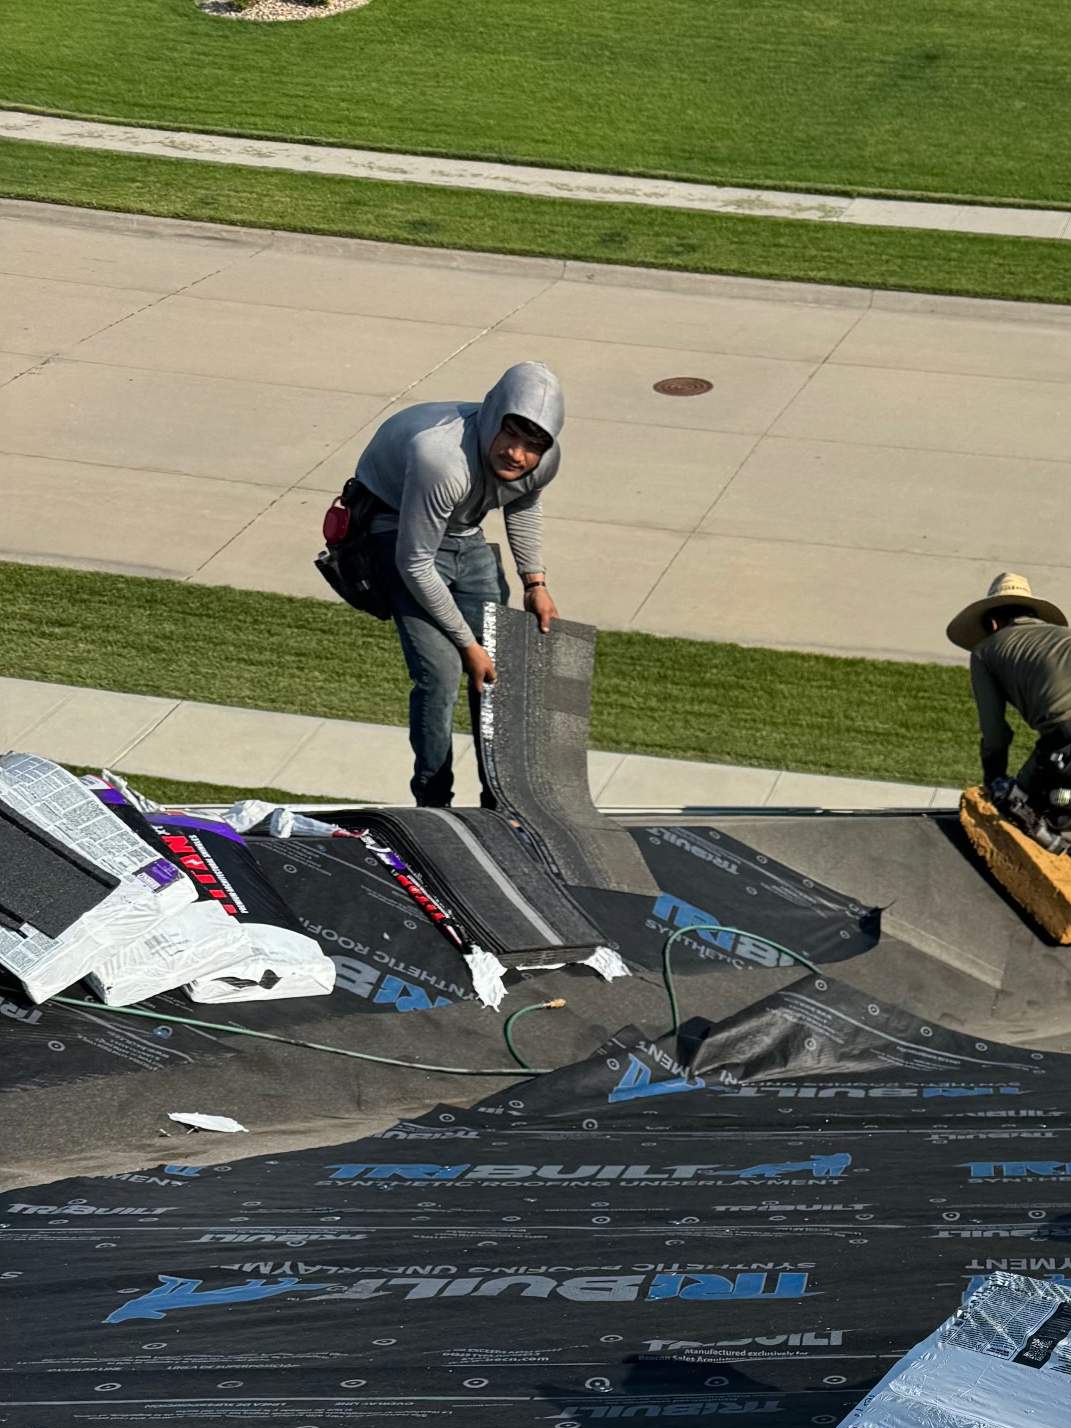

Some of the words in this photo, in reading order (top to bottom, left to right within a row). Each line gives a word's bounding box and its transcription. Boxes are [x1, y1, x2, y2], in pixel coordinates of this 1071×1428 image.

[322, 1162, 736, 1181] TRIBUILT
[312, 1178, 477, 1189] SYNTHETIC
[478, 1178, 611, 1189] ROOFING
[614, 1178, 847, 1189] UNDERLAYMENT
[6, 1202, 181, 1216] TRIBUILT
[184, 1232, 368, 1244] TRIBUILT
[302, 1270, 827, 1303] TRIBUILT
